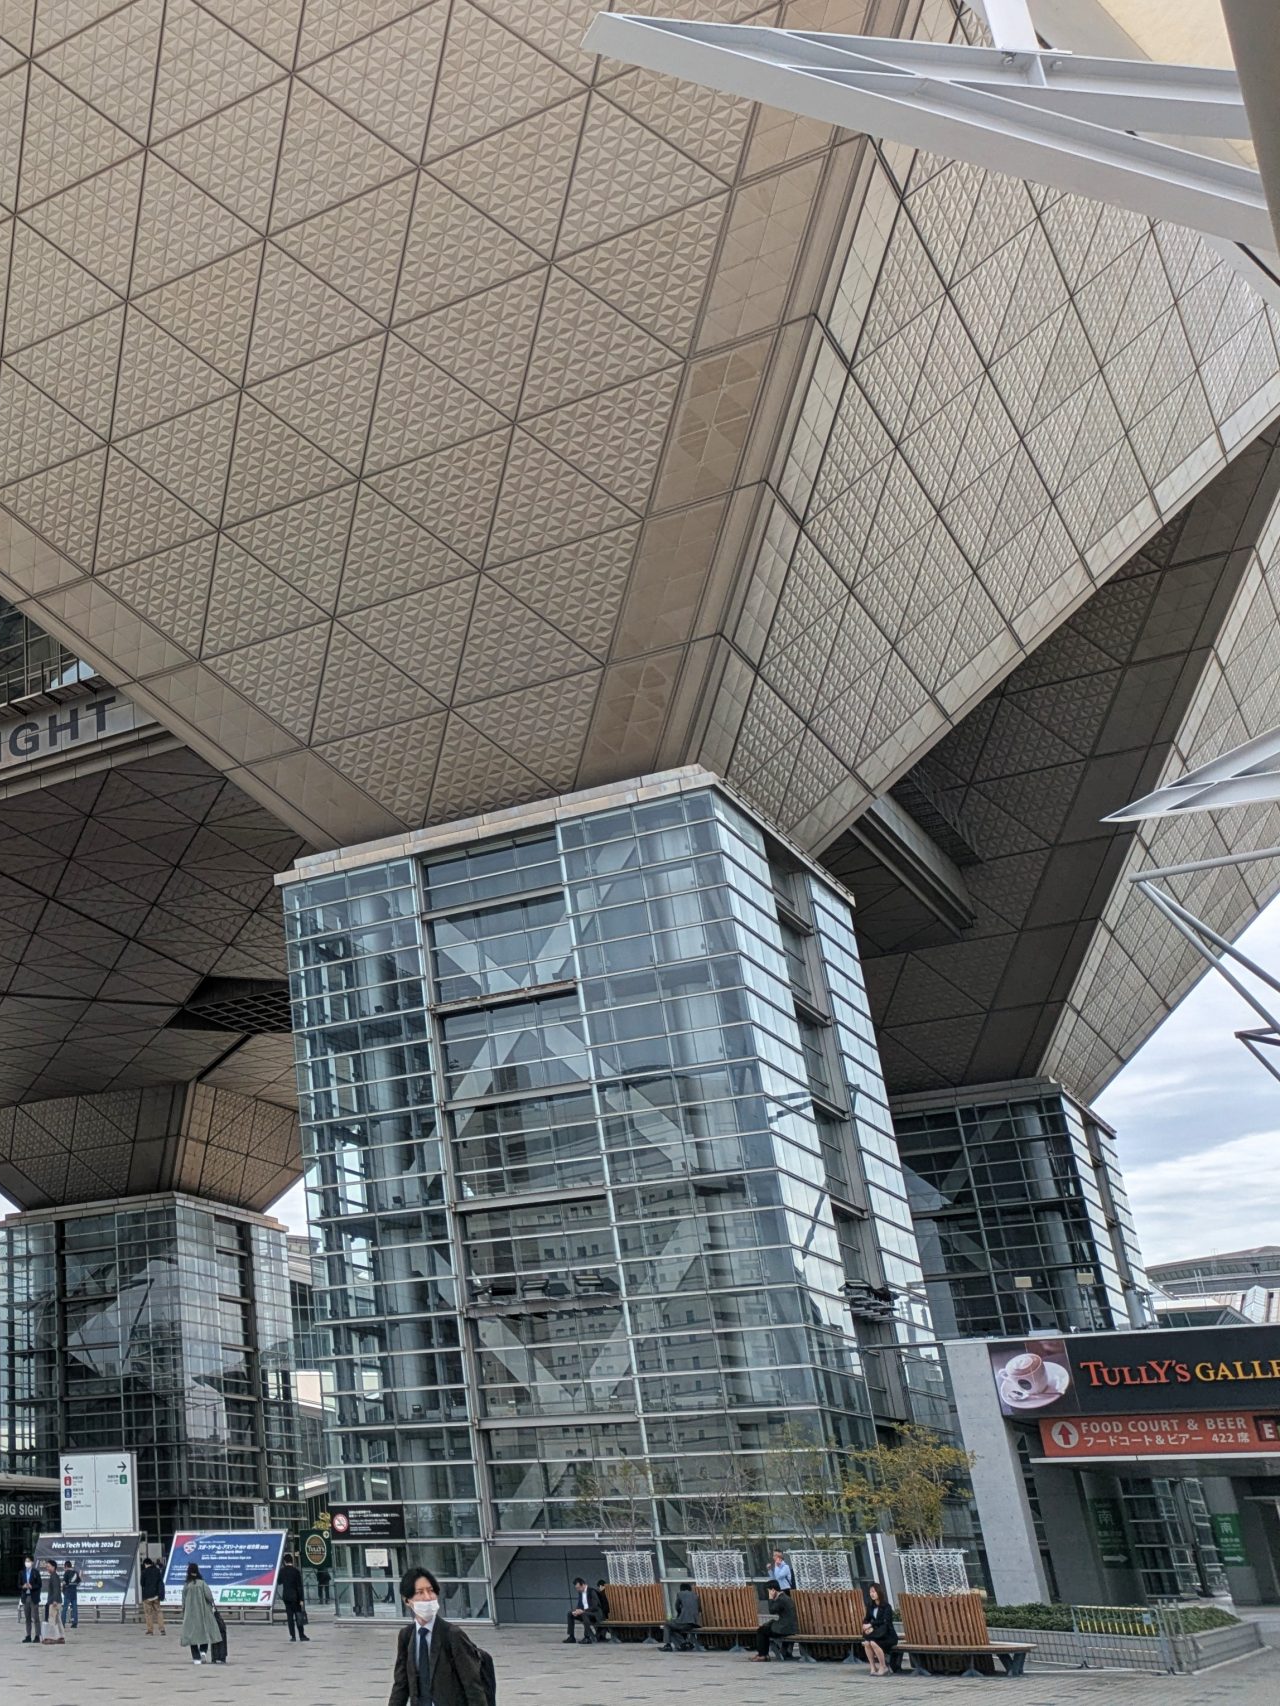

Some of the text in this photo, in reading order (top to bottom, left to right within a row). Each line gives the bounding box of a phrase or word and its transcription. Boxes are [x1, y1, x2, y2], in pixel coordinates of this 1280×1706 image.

[1080, 1360, 1192, 1386] TULLY'S
[1080, 1417, 1248, 1434] FOOD COURT & BEER
[1212, 1433, 1233, 1443] 422
[18, 1504, 44, 1516] SIGHT
[1220, 1522, 1233, 1534] 南
